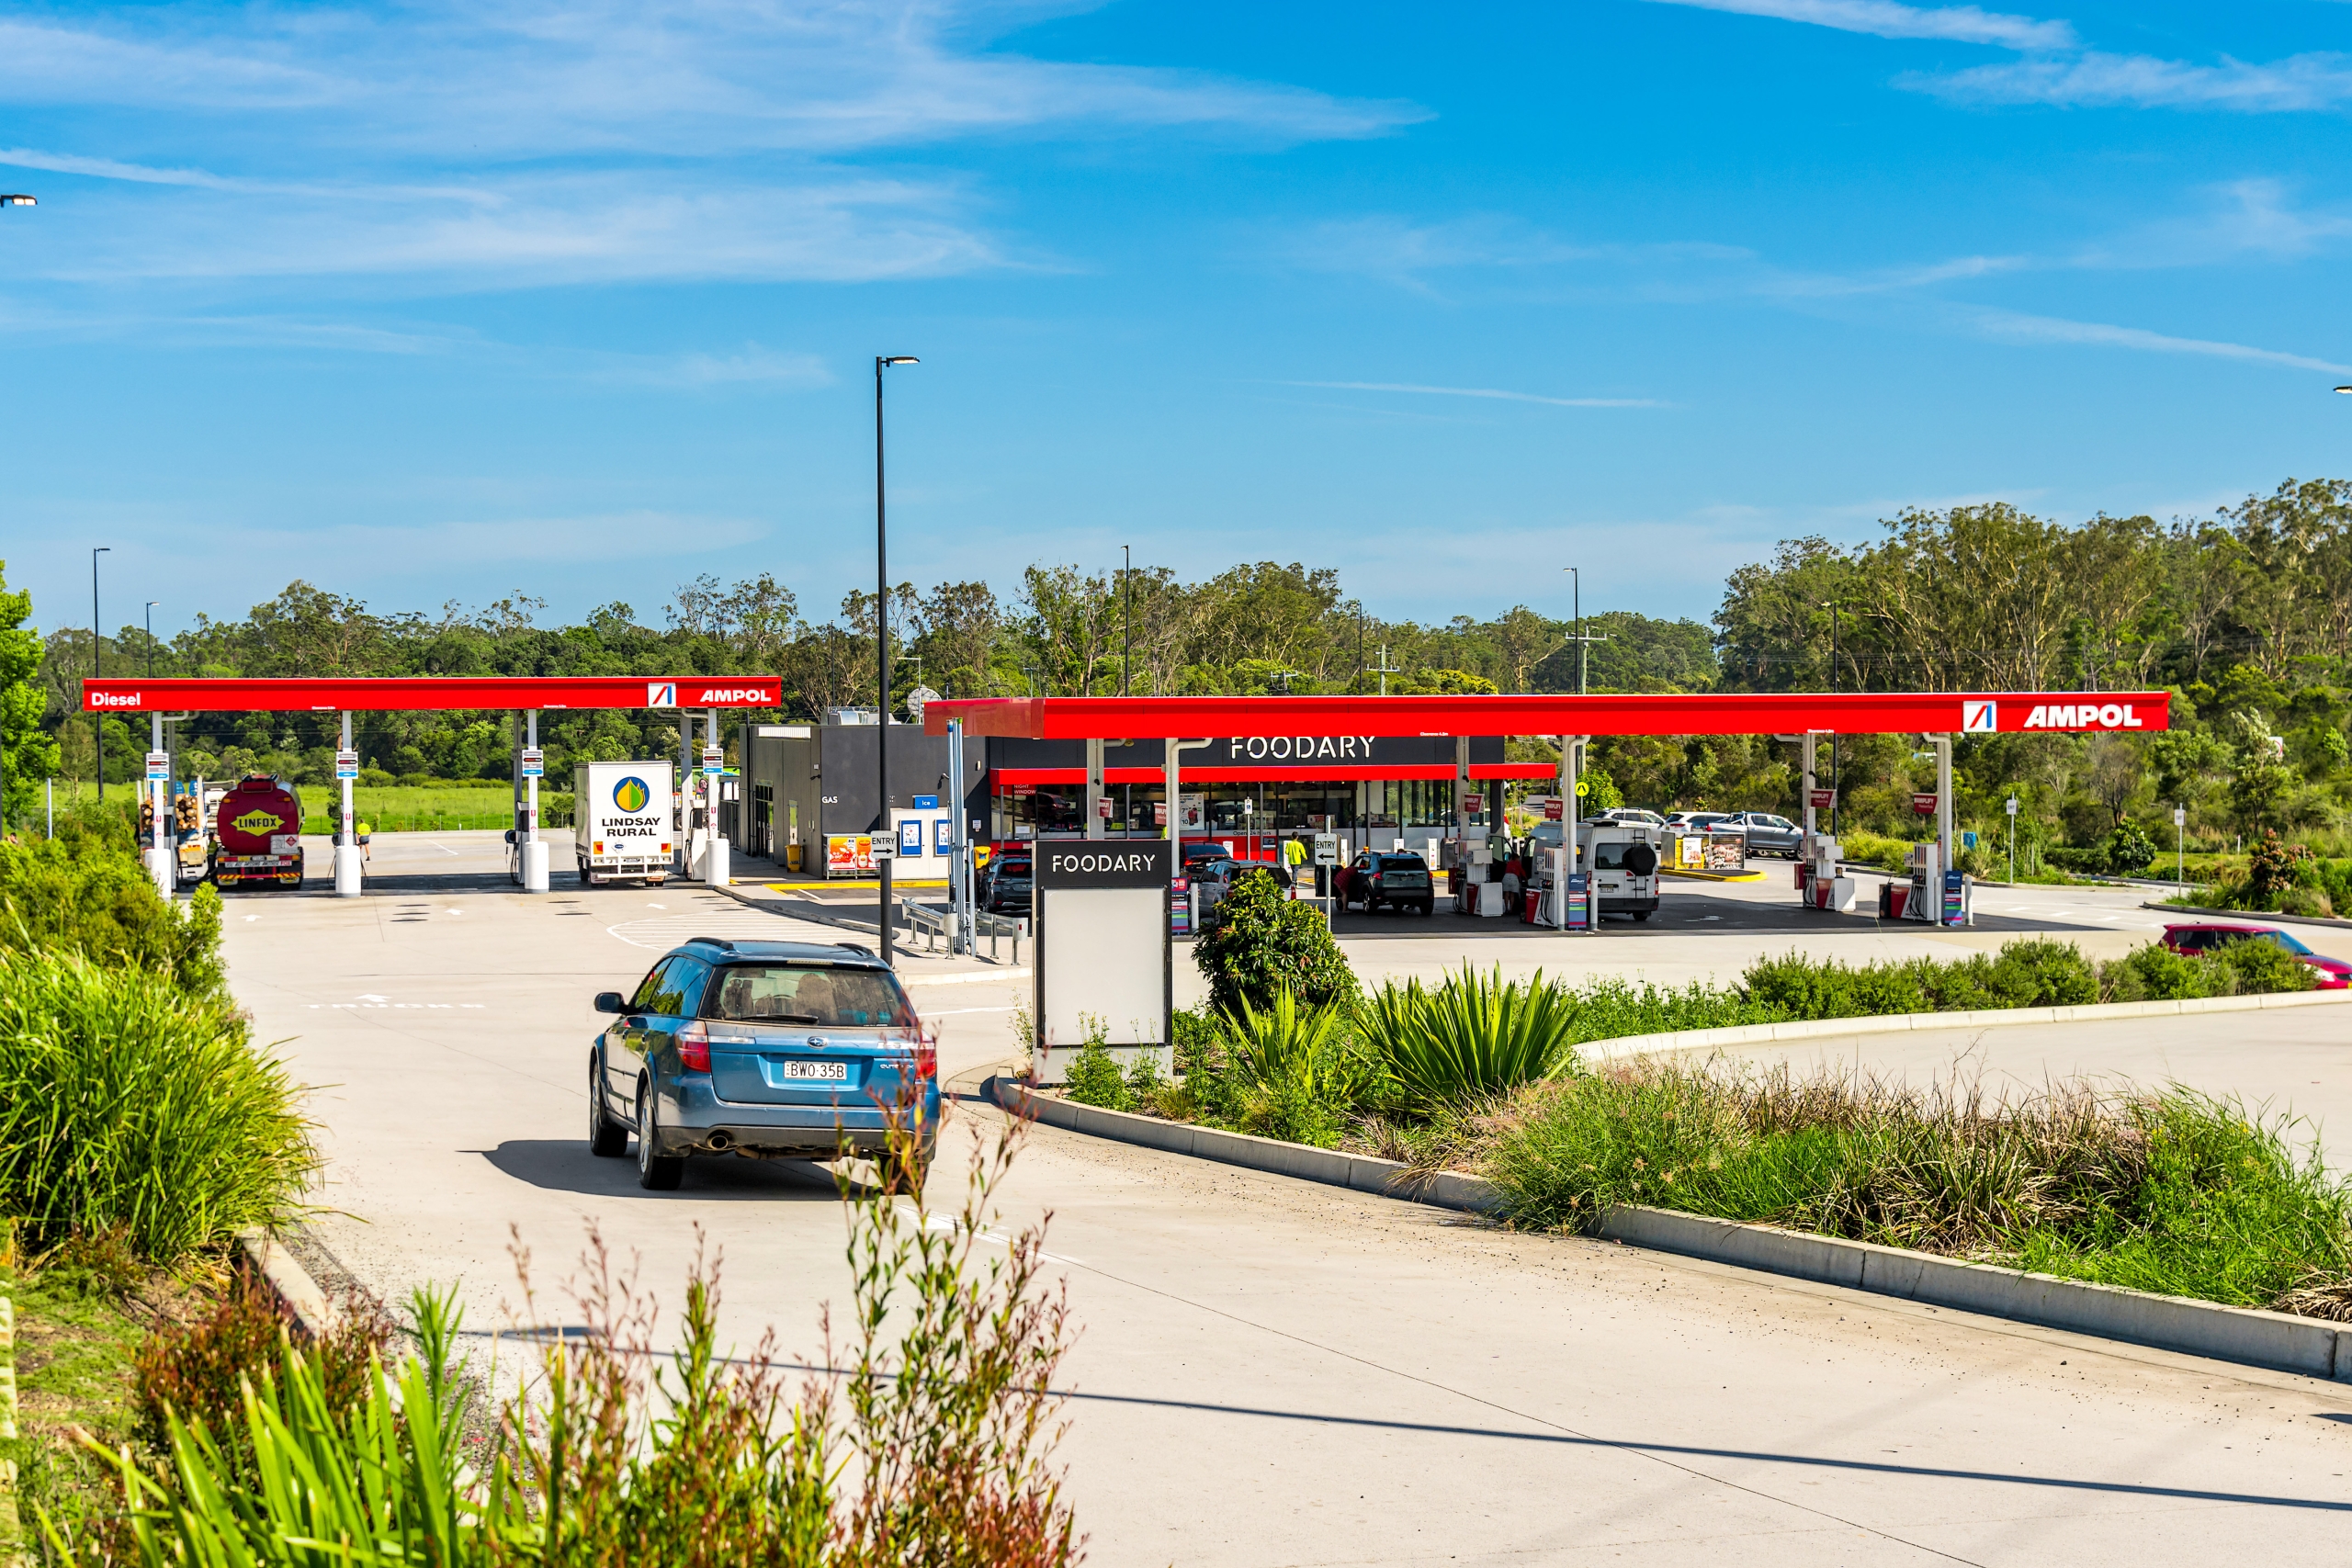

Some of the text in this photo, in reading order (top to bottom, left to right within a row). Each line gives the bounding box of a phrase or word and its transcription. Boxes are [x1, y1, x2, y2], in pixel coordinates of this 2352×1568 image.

[91, 692, 141, 705] Diesel
[699, 689, 772, 703] AMPOL
[2023, 704, 2143, 728] AMPOL
[1230, 735, 1375, 760] FOODARY
[821, 795, 838, 804] GAS
[239, 818, 277, 828] LINFOX
[602, 817, 661, 827] LINDSAY
[606, 828, 657, 837] RURAL
[872, 837, 895, 845] ENTRY
[1316, 840, 1336, 850] ENTRY
[1052, 854, 1156, 873] FOODARY
